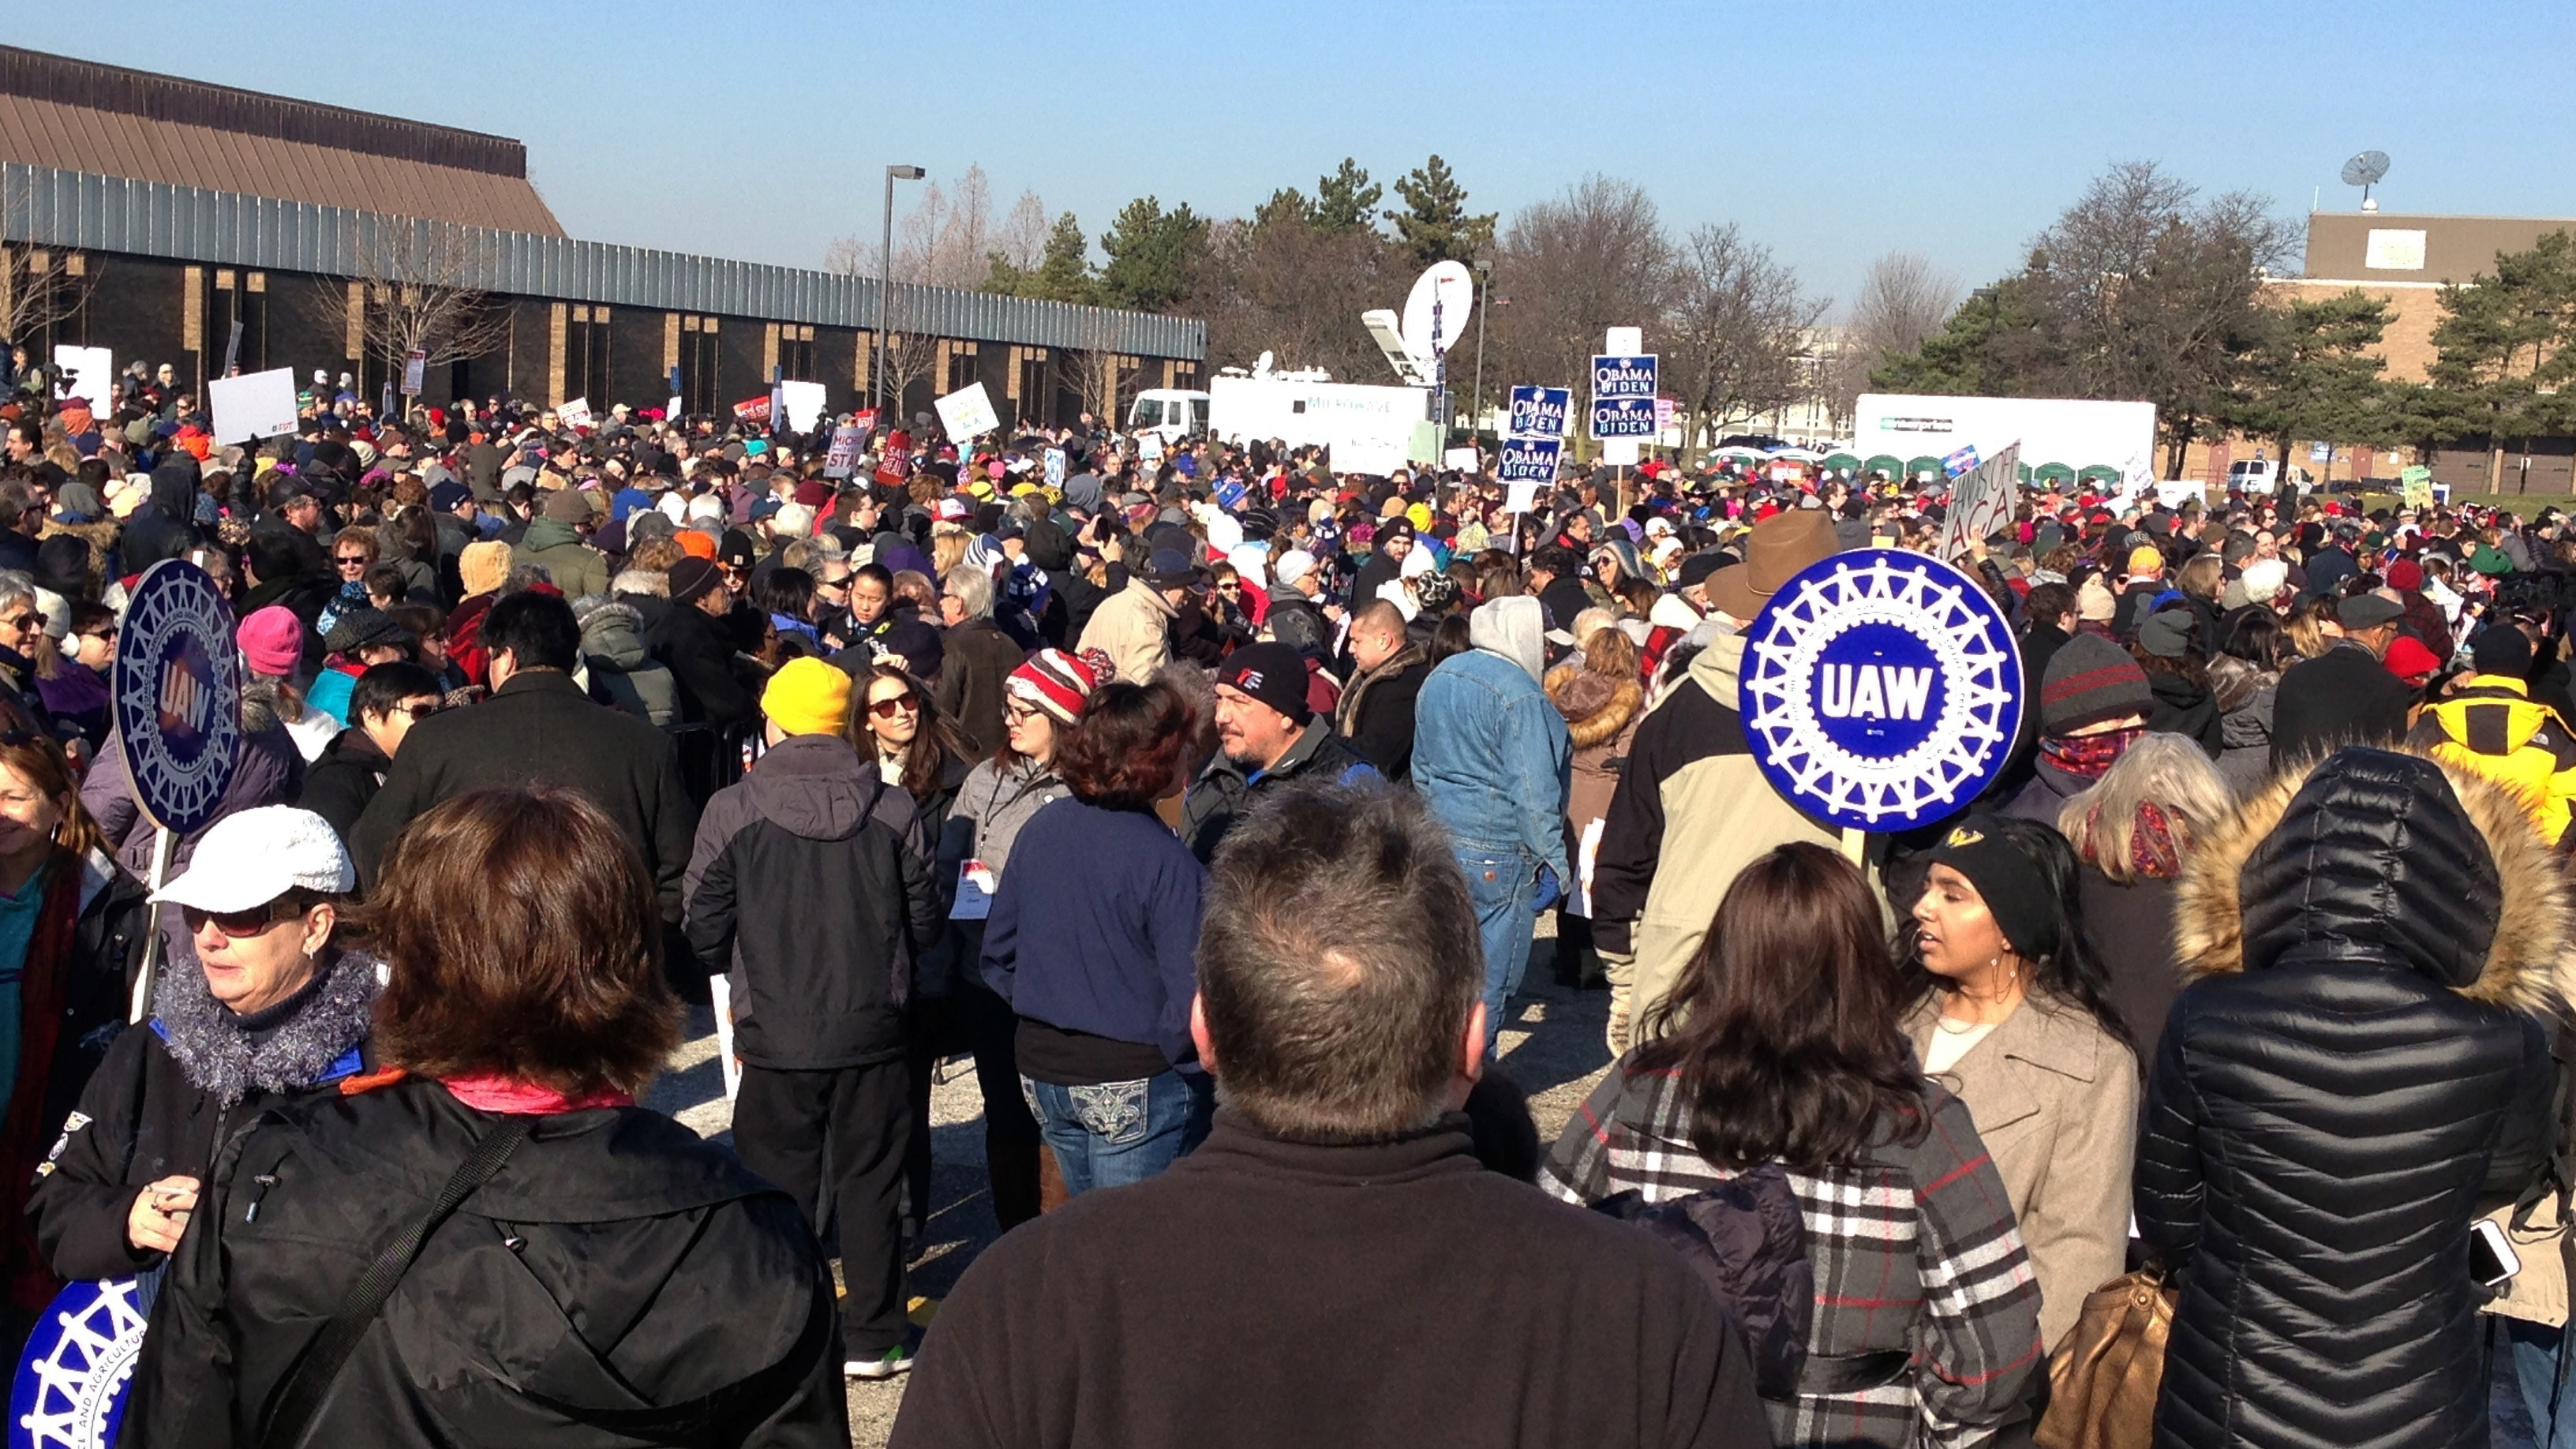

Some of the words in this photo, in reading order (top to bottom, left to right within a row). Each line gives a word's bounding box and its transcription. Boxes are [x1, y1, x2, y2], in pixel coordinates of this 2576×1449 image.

[1597, 367, 1653, 383] OBAMA
[1601, 381, 1649, 393] BIDEN
[1514, 399, 1563, 418] OBAMA
[1596, 408, 1653, 424] OBAMA
[1600, 421, 1649, 433] BIDEN
[1502, 447, 1554, 466] OBAMA
[1503, 463, 1549, 478] BIDEN
[1991, 443, 2021, 492] OFF
[1947, 488, 2010, 560] ACA
[161, 660, 211, 733] UAW
[1822, 664, 1933, 721] UAW
